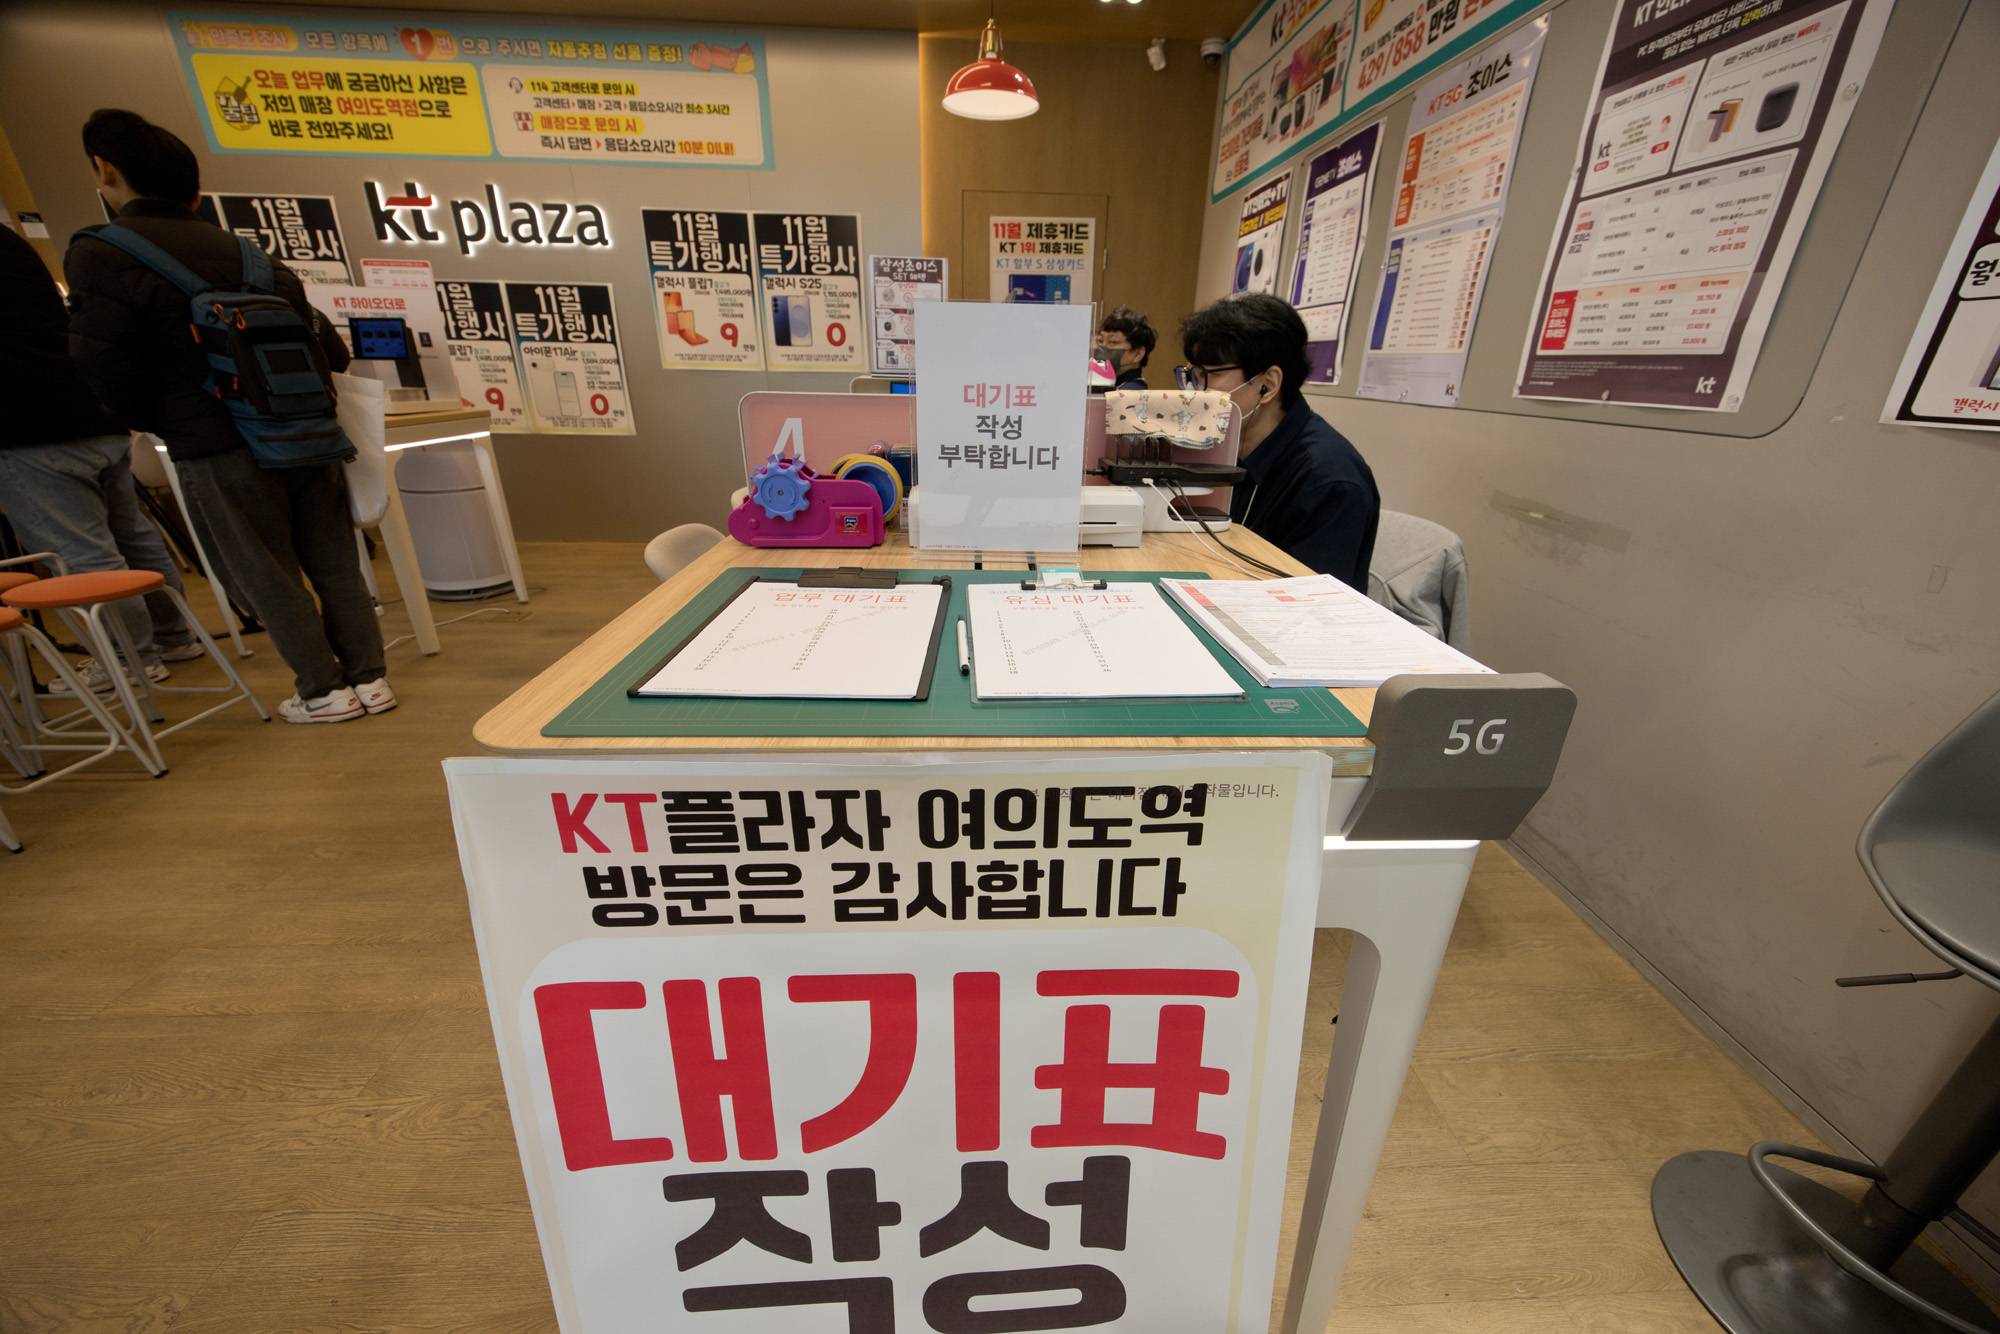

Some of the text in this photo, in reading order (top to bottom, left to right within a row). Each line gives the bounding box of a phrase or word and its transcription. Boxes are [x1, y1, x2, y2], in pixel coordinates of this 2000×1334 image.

[1633, 3, 1651, 28] KT
[304, 31, 336, 51] 모든
[497, 38, 543, 58] 주시면
[546, 40, 607, 60] 자동추첨
[613, 42, 642, 62] 선물
[647, 44, 684, 63] 증정!
[1357, 21, 1426, 90] 429/858
[1427, 0, 1461, 45] 만원
[253, 69, 468, 96] 오늘 업무에 궁금하신 사항은
[530, 80, 636, 96] 114 고객센터로 문의 시
[1465, 53, 1513, 100] 초이스
[262, 94, 453, 119] 저희 매장 여의도역점으로
[532, 97, 731, 116] 고객센터 매장 고객 응답소요시간 최소 3시간
[268, 120, 394, 140] 바로 전화주세요!
[540, 116, 637, 134] 매장으로 문의 시
[540, 135, 735, 157] 즉시 답변 응답소요시간 10분 이내!
[1597, 141, 1612, 160] kt
[251, 198, 304, 230] 11월
[364, 180, 609, 255] kt plaza
[671, 212, 720, 245] 11월
[782, 215, 829, 246] 11월
[993, 222, 1089, 240] 11월 제휴카드
[650, 240, 749, 273] 특가행사
[760, 243, 856, 275] 특가행사
[999, 242, 1084, 255] KT 1위 제휴카드
[880, 258, 938, 273] 삼성초이스
[892, 272, 909, 281] SET
[996, 257, 1086, 271] KT 할부 S 삼성카드
[654, 276, 713, 290] 갤럭시 플립7
[763, 276, 822, 290] 갤럭시 S25
[333, 296, 407, 311] KT 하이오더로
[534, 286, 582, 314] 11월
[514, 312, 612, 343] 특가행사
[720, 322, 739, 348] 9
[826, 322, 847, 347] 0
[963, 383, 1037, 409] 대기표
[1695, 376, 1717, 394] kt
[485, 387, 504, 411] 9
[590, 393, 609, 416] 0
[1952, 398, 2000, 414] 갤럭시
[976, 414, 1023, 440] 작성
[938, 444, 1060, 471] 부탁합니다
[775, 592, 908, 604] 업무 대기표
[1003, 594, 1137, 605] 유심 대기표
[1443, 718, 1508, 756] 5G
[549, 783, 1207, 855] KT플라자 여의도역
[583, 857, 1186, 928] 방문은 감사합니다
[533, 968, 1240, 1172] 대기표
[662, 1154, 1132, 1334] 작성
